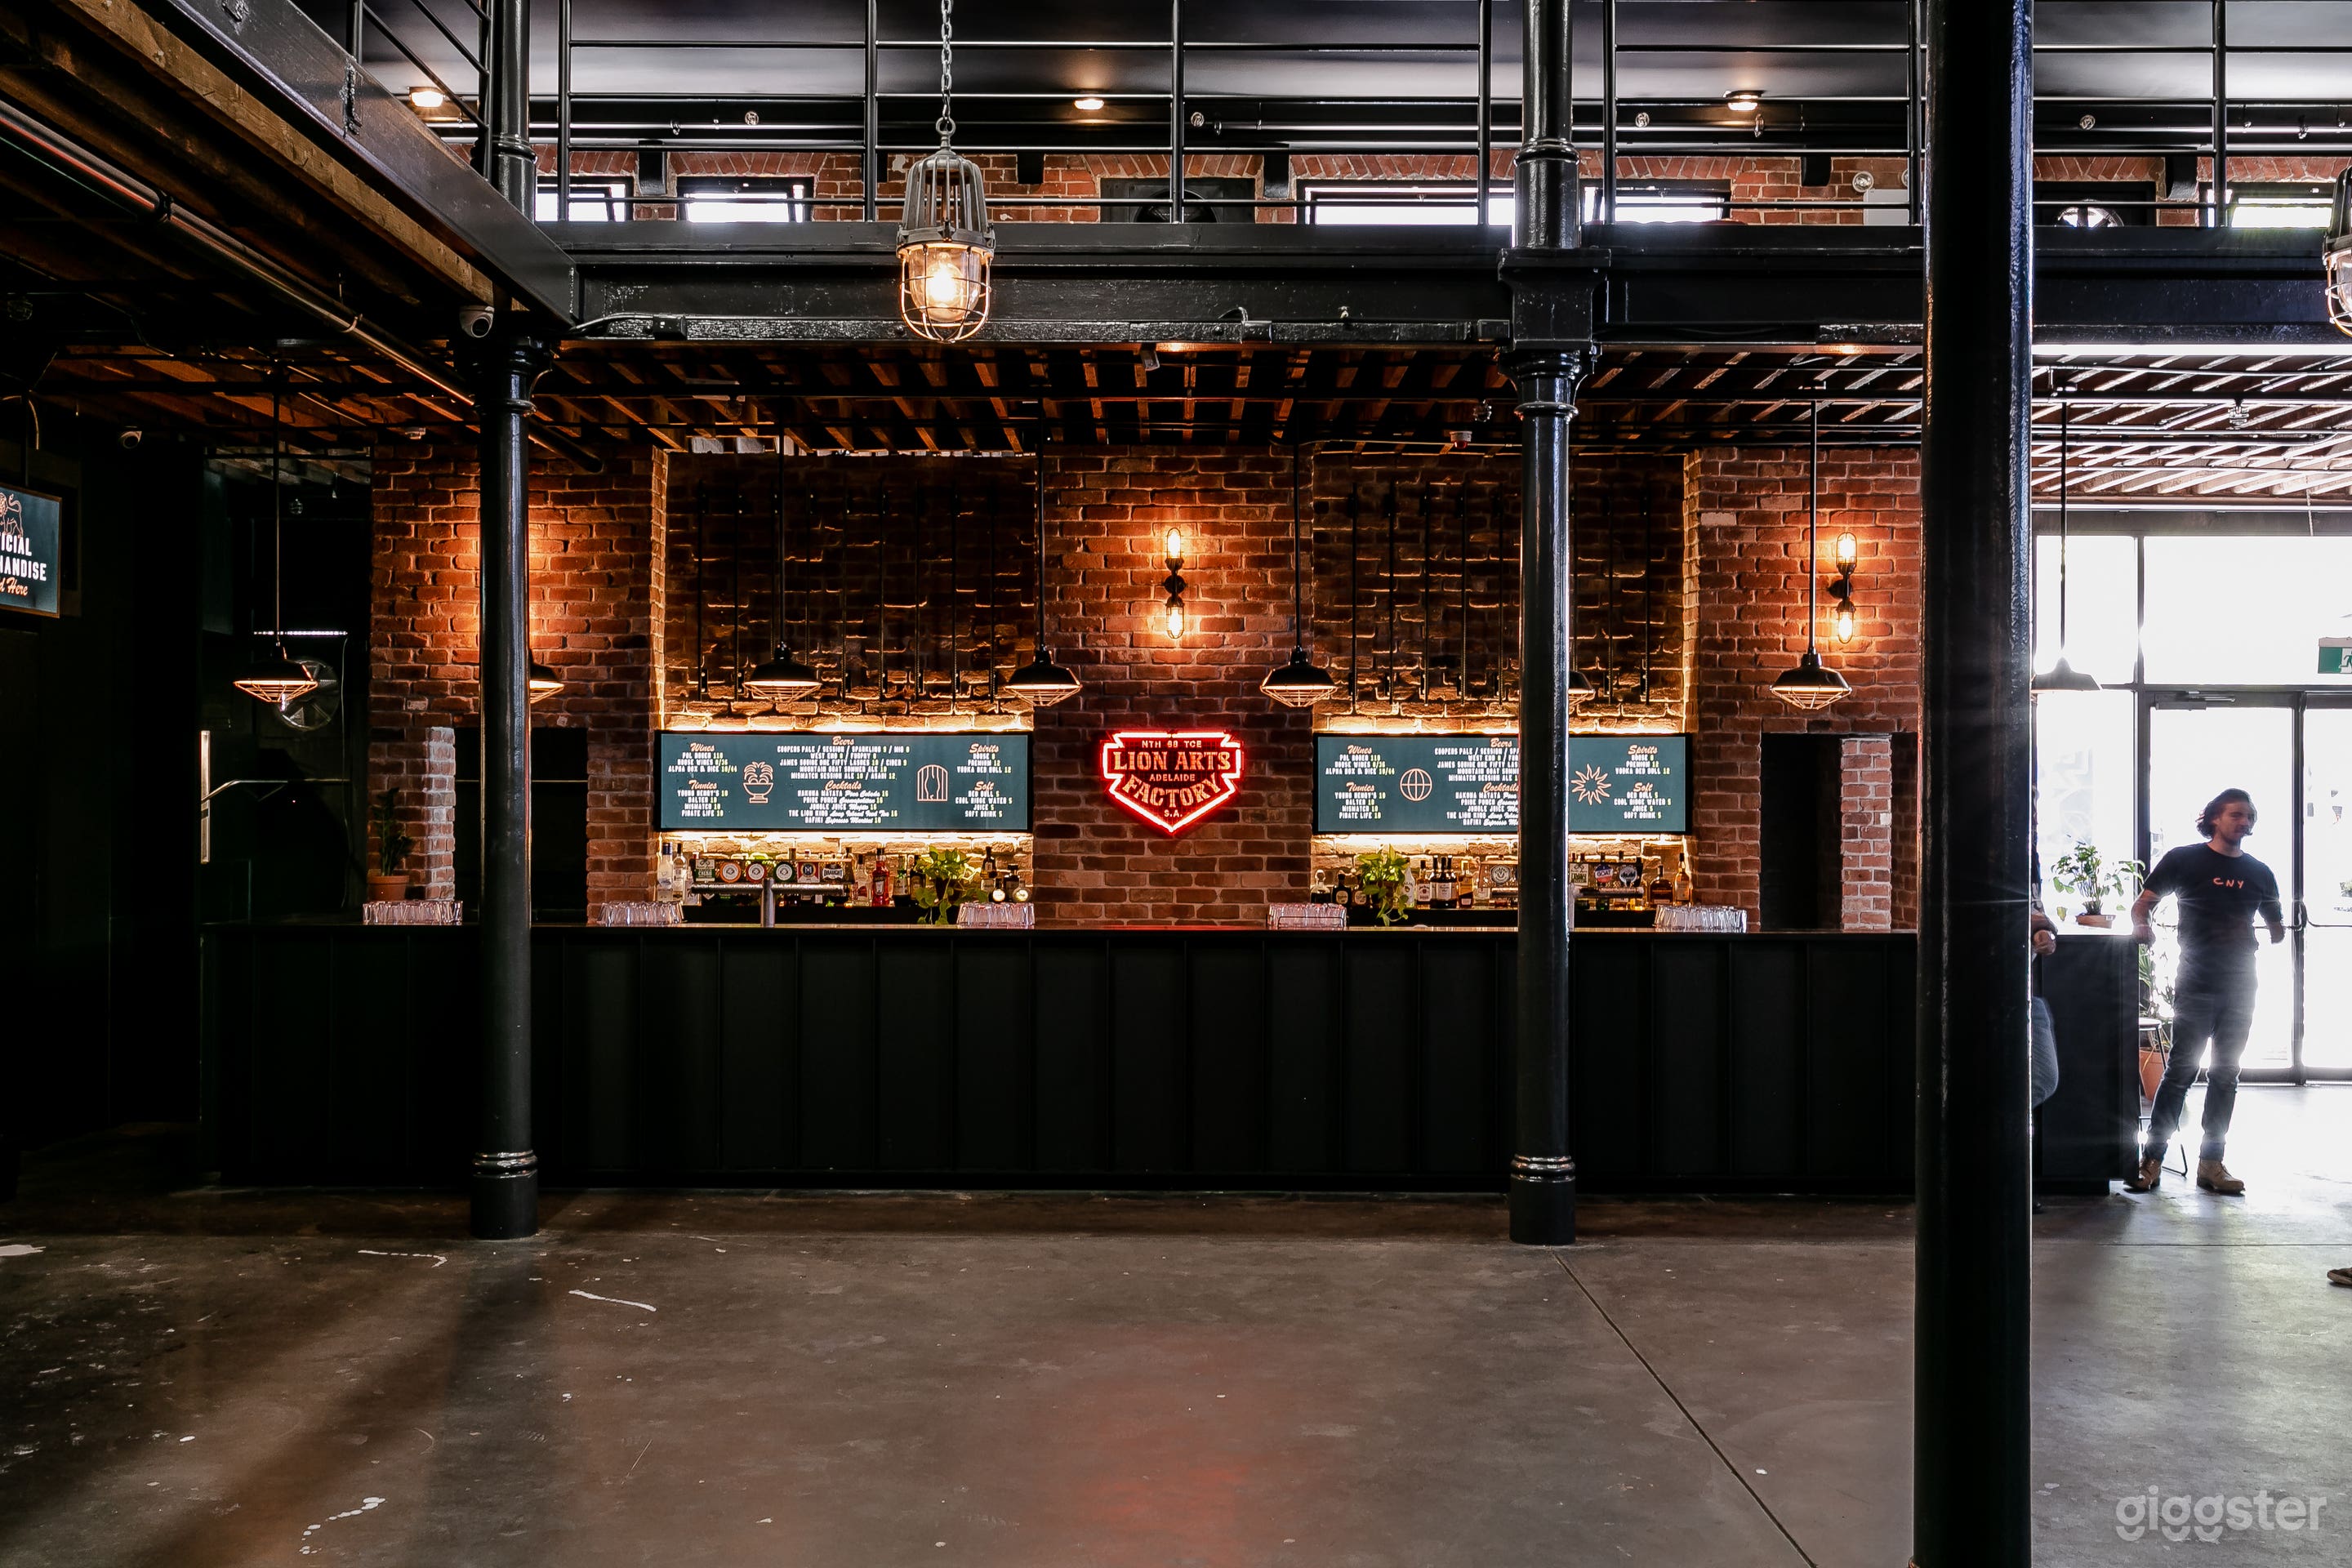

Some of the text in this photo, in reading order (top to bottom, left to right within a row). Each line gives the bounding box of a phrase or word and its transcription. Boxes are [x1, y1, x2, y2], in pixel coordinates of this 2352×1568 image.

[0, 531, 32, 556] ICIAL
[7, 577, 29, 596] Here
[832, 736, 854, 745] Beers
[1142, 740, 1161, 748] NTH
[1184, 740, 1202, 748] TCE
[1490, 737, 1512, 746] Beers
[690, 743, 715, 752] Wines
[969, 743, 999, 754] Spirits
[1348, 745, 1372, 754] Wines
[1628, 745, 1658, 755] Spirits
[1113, 751, 1232, 770] LION ARTS
[1149, 773, 1196, 782] ADELAIDE
[825, 780, 862, 790] Cocktails
[974, 782, 995, 791] Soft
[1633, 783, 1653, 793] Soft
[1121, 772, 1221, 808] FACTORY
[1164, 809, 1183, 817] S.A.
[1597, 869, 1611, 877] GOAT
